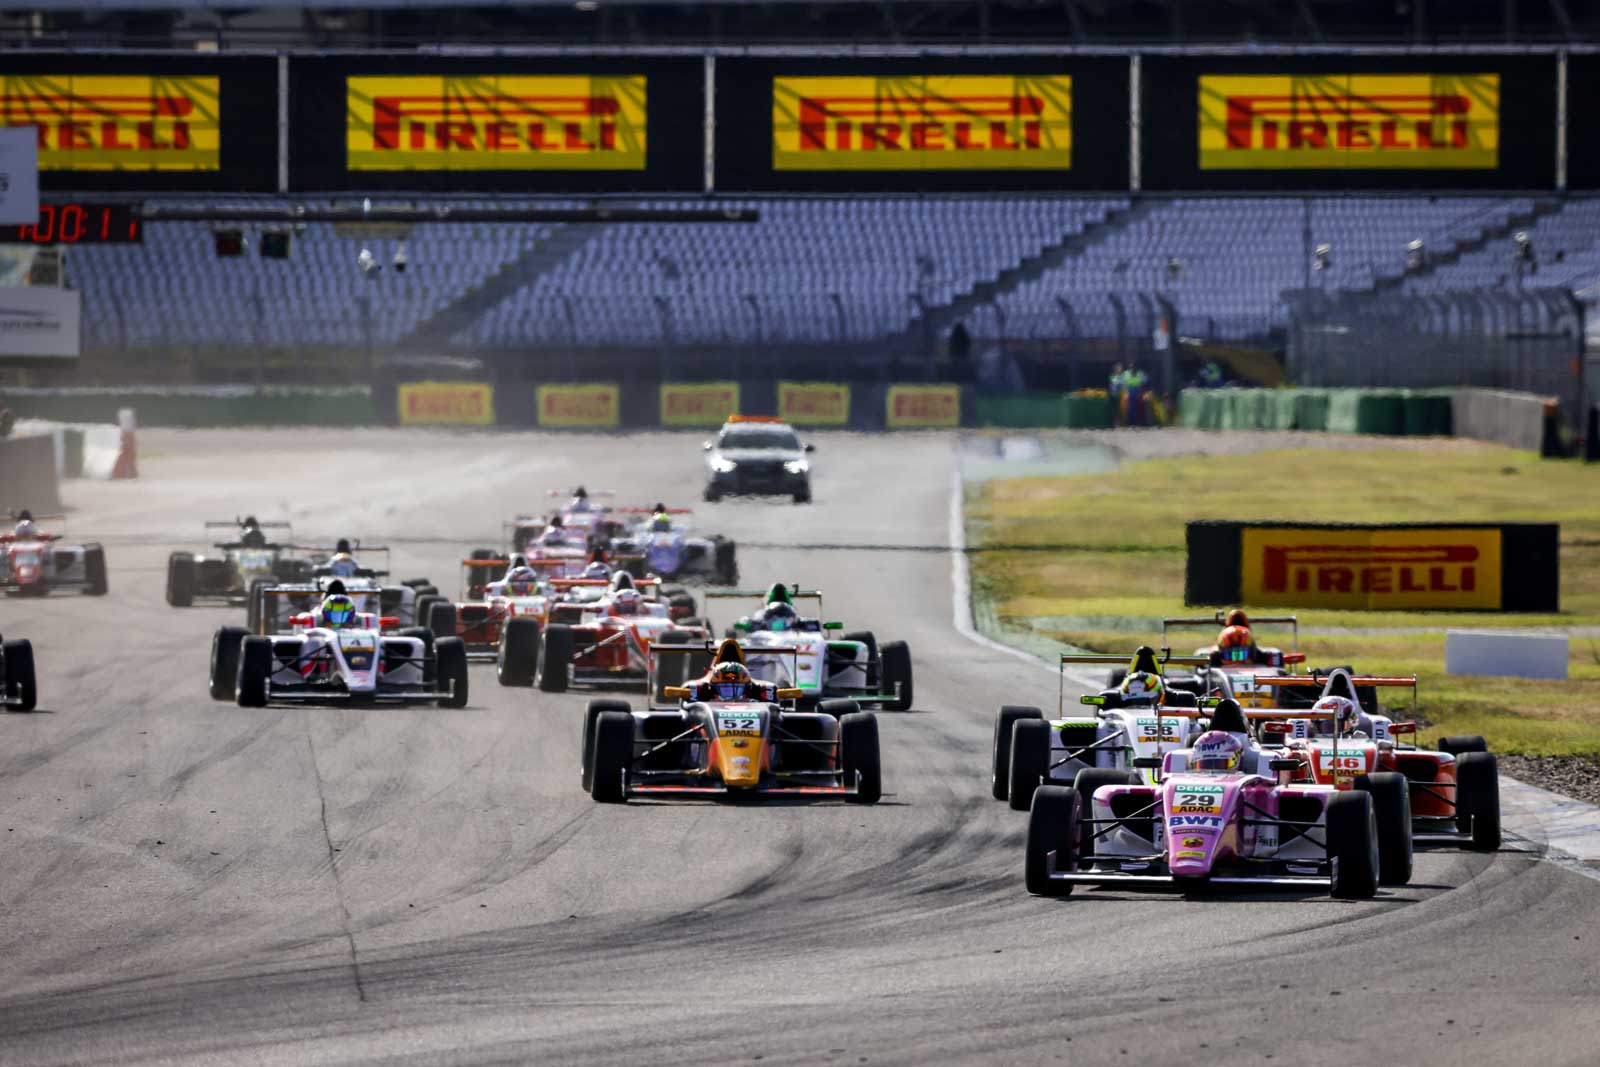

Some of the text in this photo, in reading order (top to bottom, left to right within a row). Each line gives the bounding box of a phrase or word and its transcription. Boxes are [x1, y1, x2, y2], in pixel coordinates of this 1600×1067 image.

[373, 96, 620, 150] PIRELLI
[799, 96, 1045, 151] PIRELLI
[1226, 95, 1472, 150] PIRELLI
[1263, 545, 1479, 593] PIRELLI
[724, 719, 754, 729] 52
[1143, 726, 1173, 735] 58
[1327, 758, 1359, 768] 46
[1180, 794, 1215, 806] 29
[1169, 816, 1222, 827] BWT
